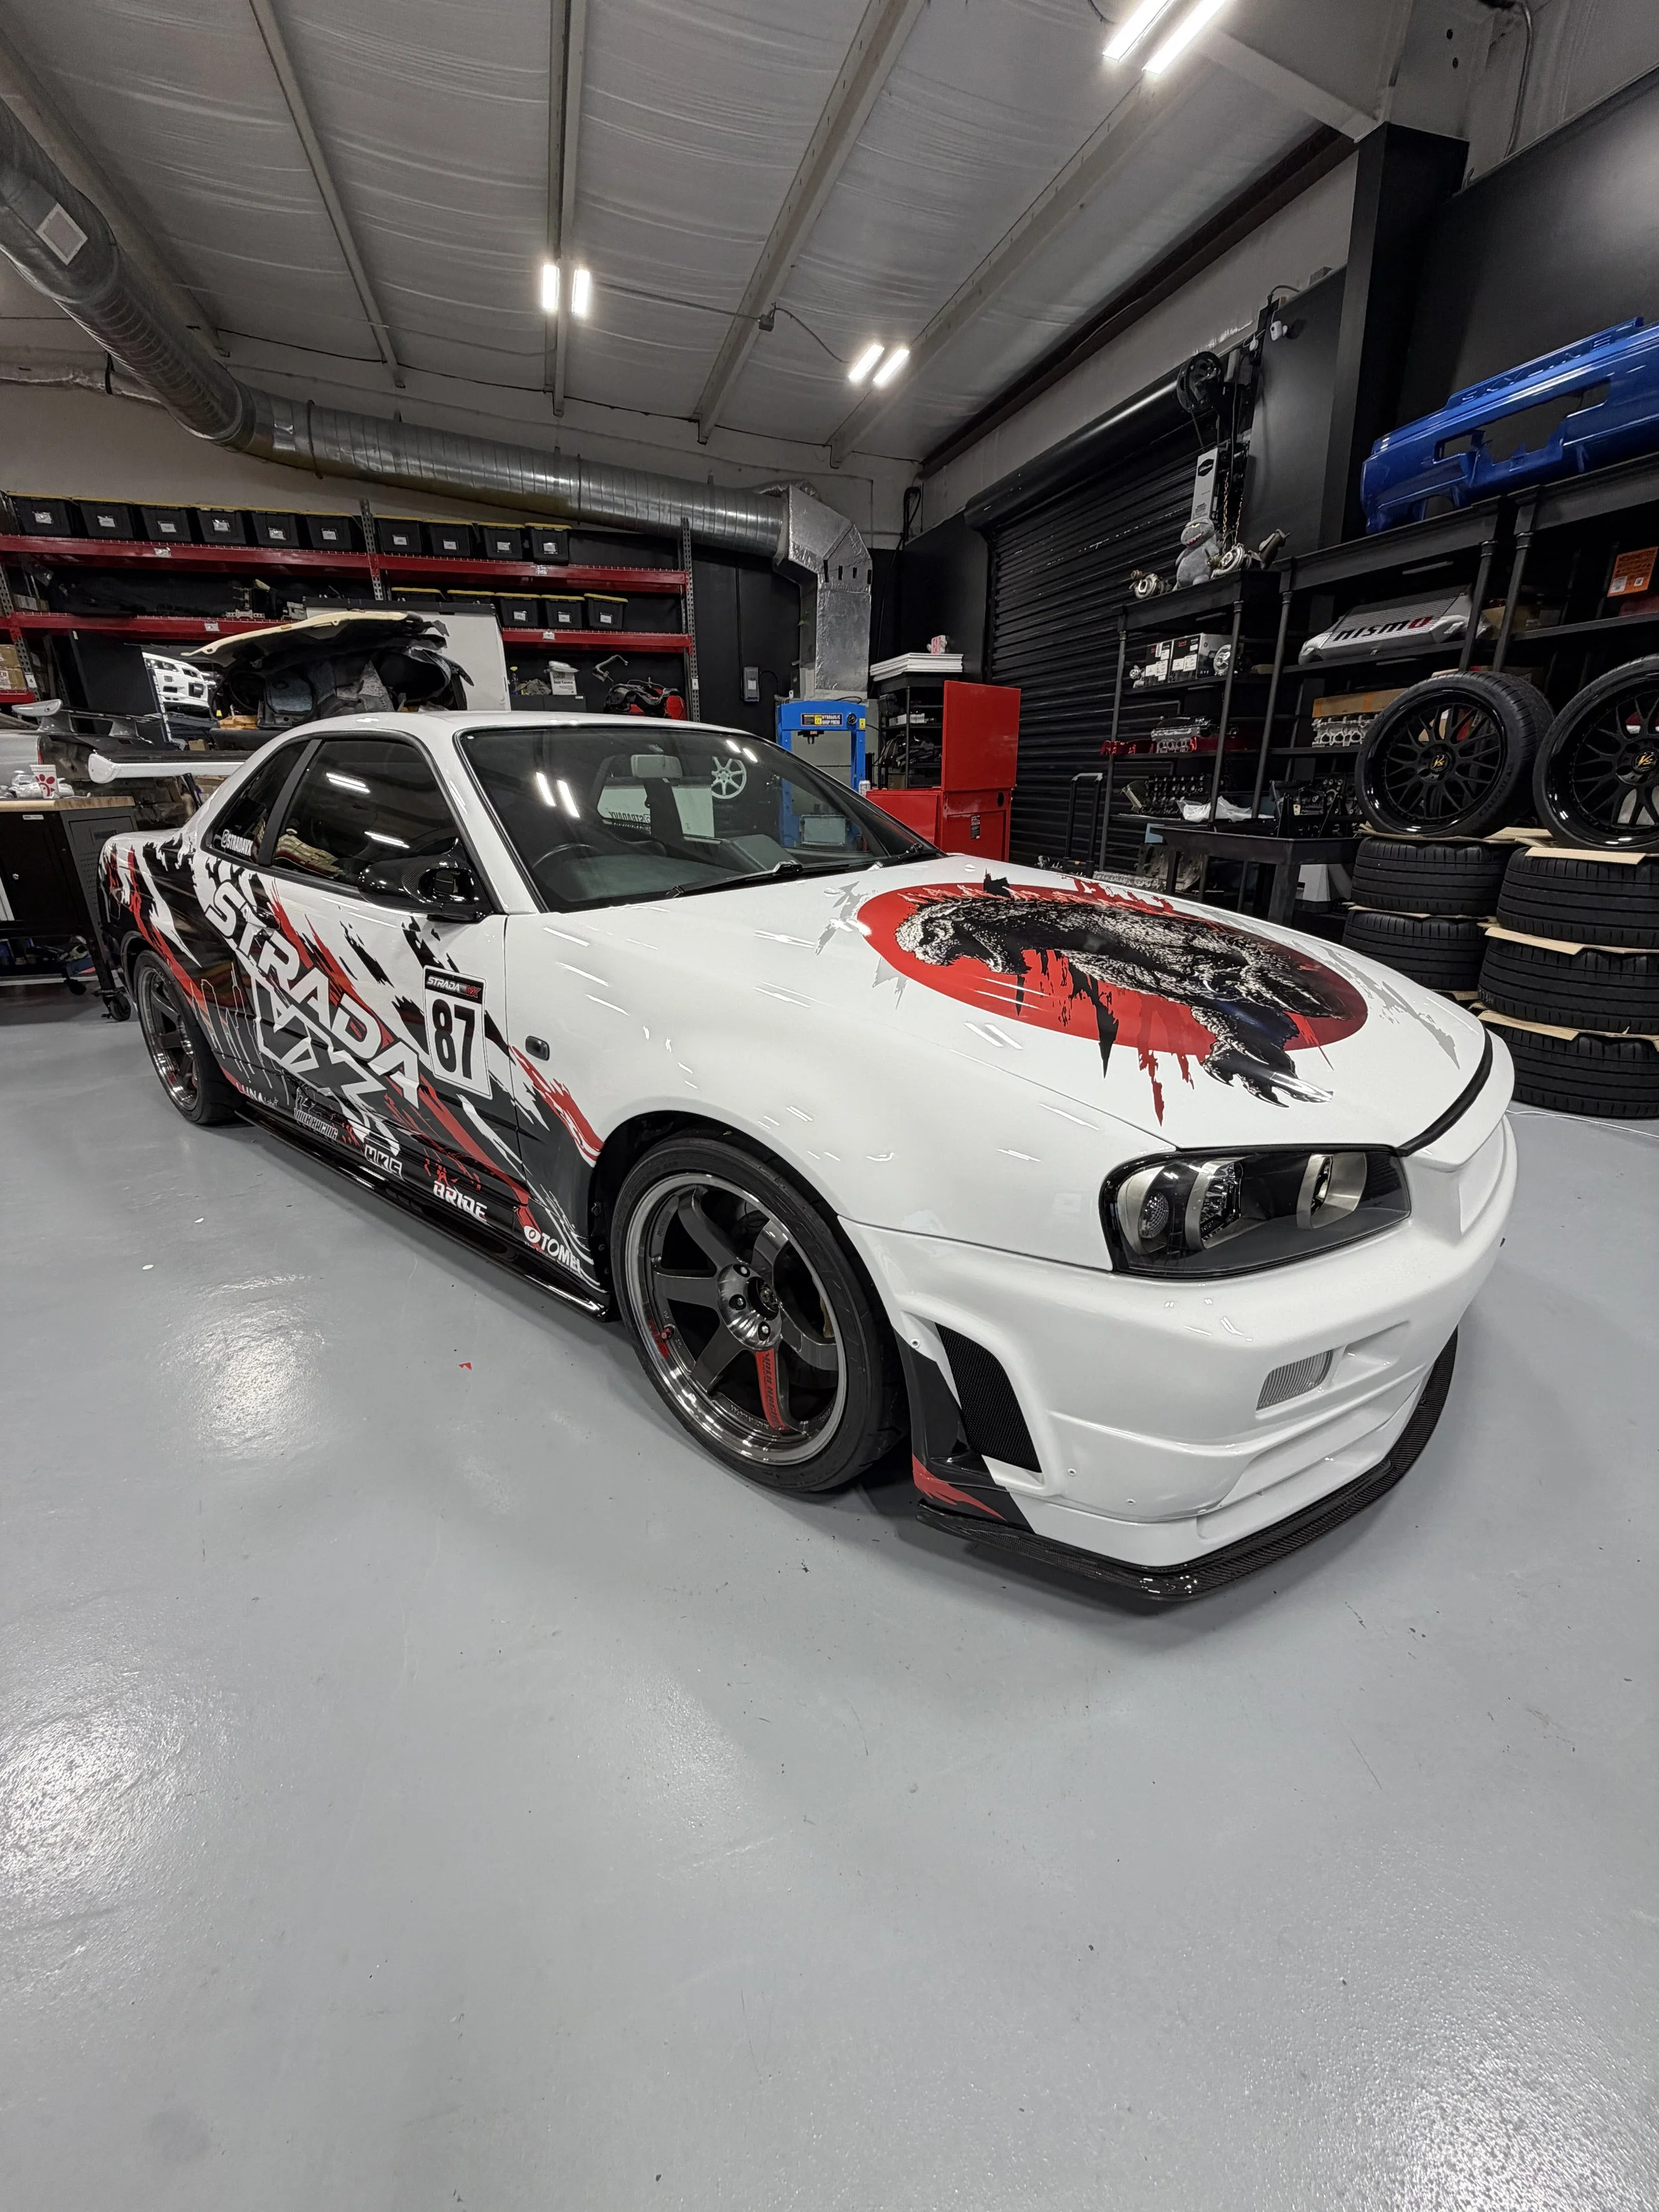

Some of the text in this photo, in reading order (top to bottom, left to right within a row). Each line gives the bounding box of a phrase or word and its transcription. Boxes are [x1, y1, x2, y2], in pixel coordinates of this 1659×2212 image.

[1333, 616, 1434, 641] nismo
[432, 998, 475, 1080] 87
[433, 1180, 488, 1222] BRIDE
